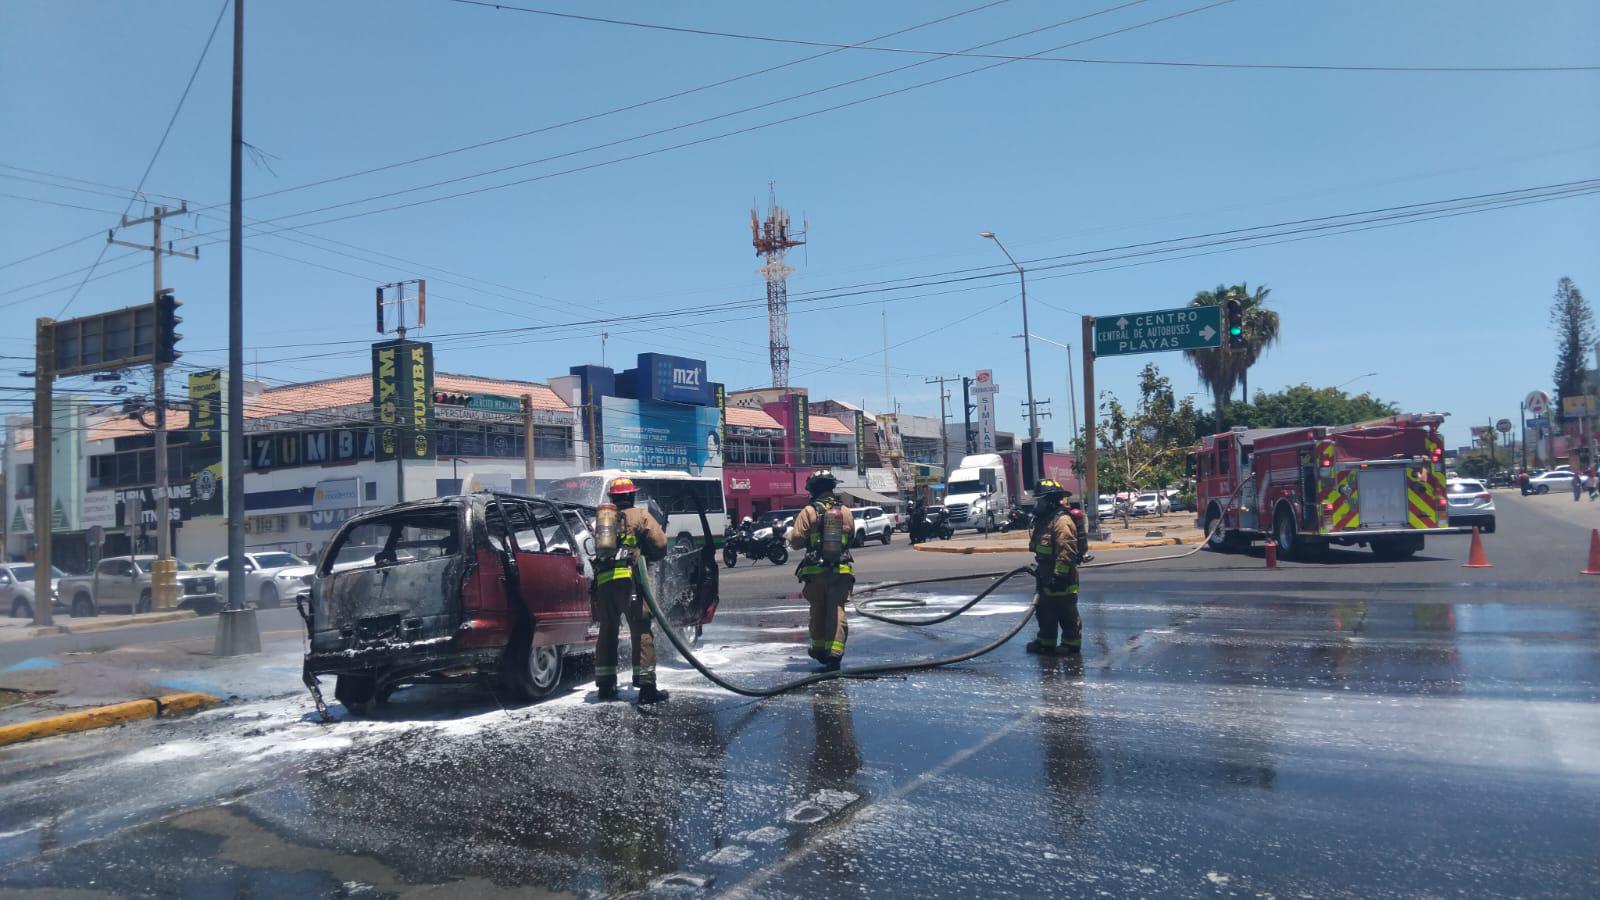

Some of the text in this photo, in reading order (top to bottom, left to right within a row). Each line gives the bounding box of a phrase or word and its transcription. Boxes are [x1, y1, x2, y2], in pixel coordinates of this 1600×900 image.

[1135, 311, 1198, 327] CENTRO
[1098, 323, 1191, 342] CENTRAL DE AUTOBUSES
[1119, 336, 1180, 352] PLAYAS
[673, 367, 700, 385] mzt
[379, 349, 395, 425] GYM
[412, 347, 427, 431] ZUMBA
[439, 408, 480, 420] PERSIANAS
